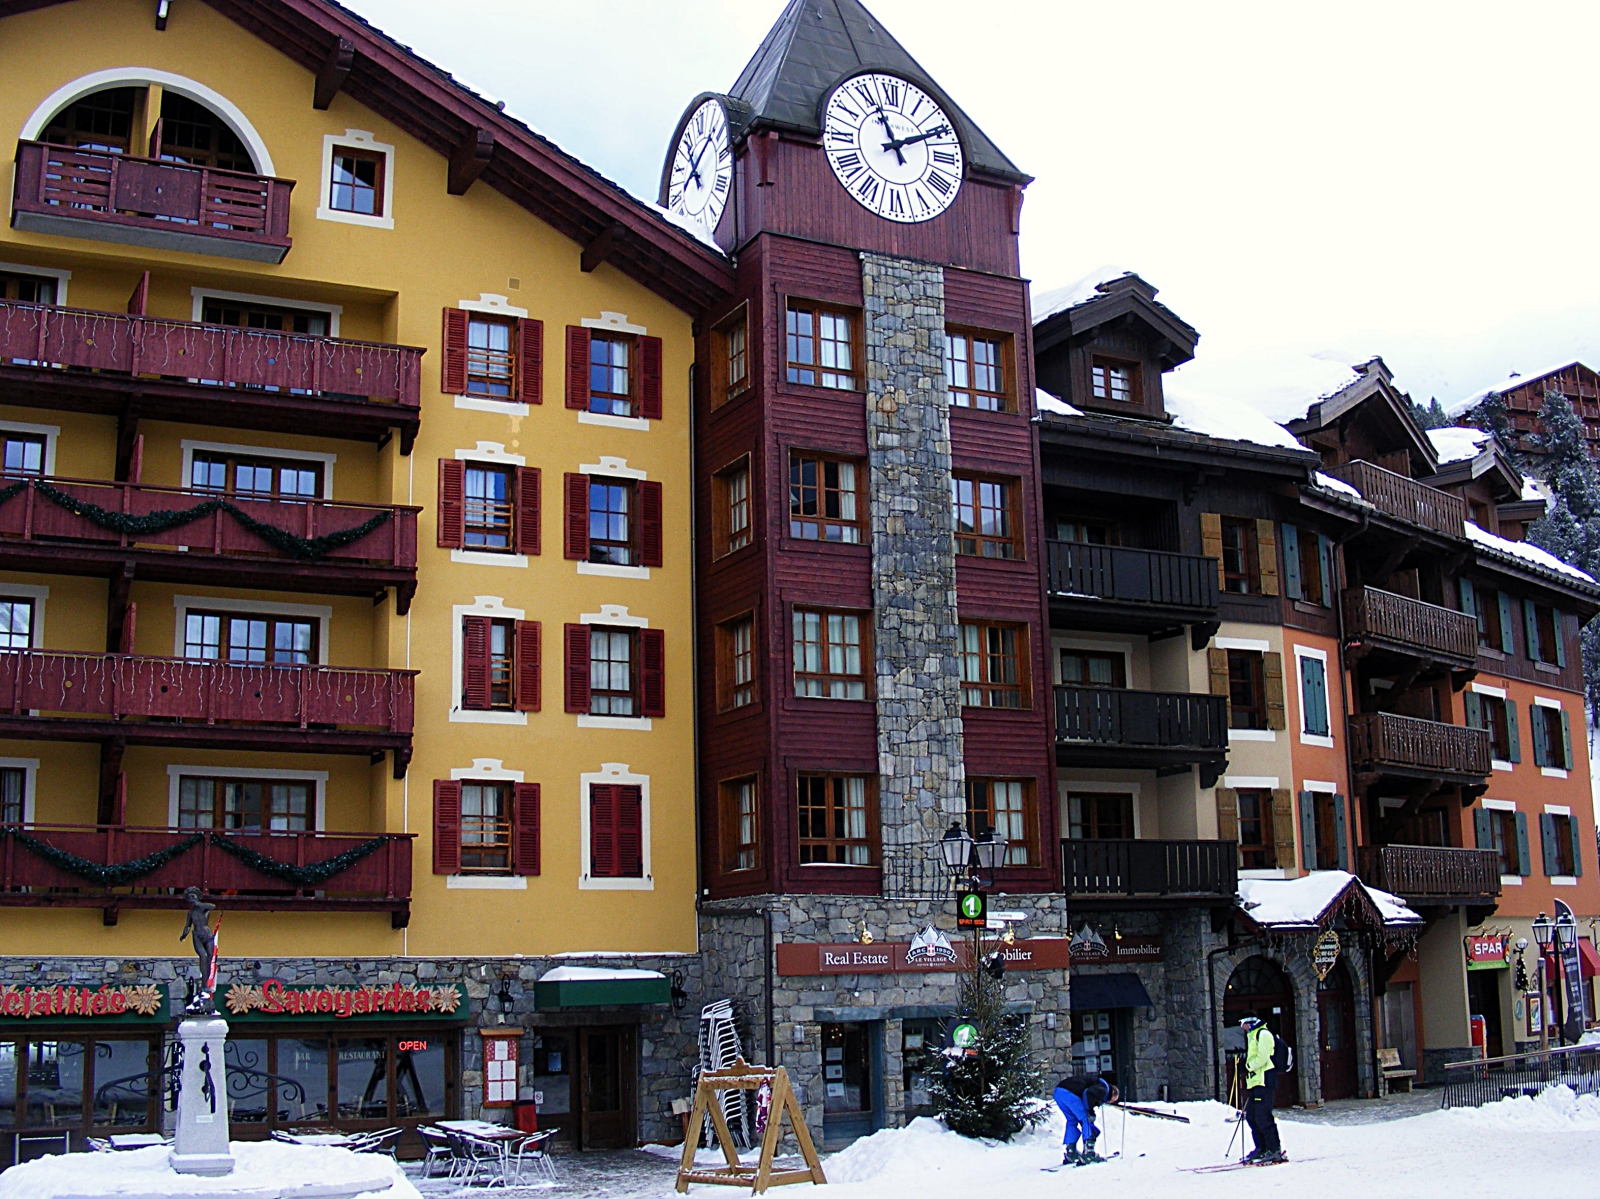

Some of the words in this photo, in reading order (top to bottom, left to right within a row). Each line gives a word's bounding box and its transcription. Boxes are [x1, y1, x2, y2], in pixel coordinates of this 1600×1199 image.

[855, 84, 876, 108] XI
[882, 83, 899, 108] XII
[836, 100, 859, 121] X
[911, 98, 923, 116] I
[831, 125, 853, 144] IX
[872, 119, 914, 133] INAWEST
[836, 152, 863, 179] VIII
[934, 150, 955, 165] III
[858, 176, 879, 203] VII
[927, 170, 952, 195] IIII
[890, 189, 904, 213] VI
[916, 188, 930, 211] V
[966, 897, 975, 915] 1
[1001, 949, 1032, 960] obilier
[1117, 945, 1160, 955] Immobilier
[1475, 942, 1502, 954] SPAR
[825, 952, 850, 965] Real
[853, 952, 888, 964] Estate
[0, 984, 125, 1015] cialités
[260, 979, 430, 1018] Savoyardes
[958, 1027, 970, 1044] 1
[399, 1041, 427, 1050] OPEN
[339, 1051, 385, 1060] RESTAURANT
